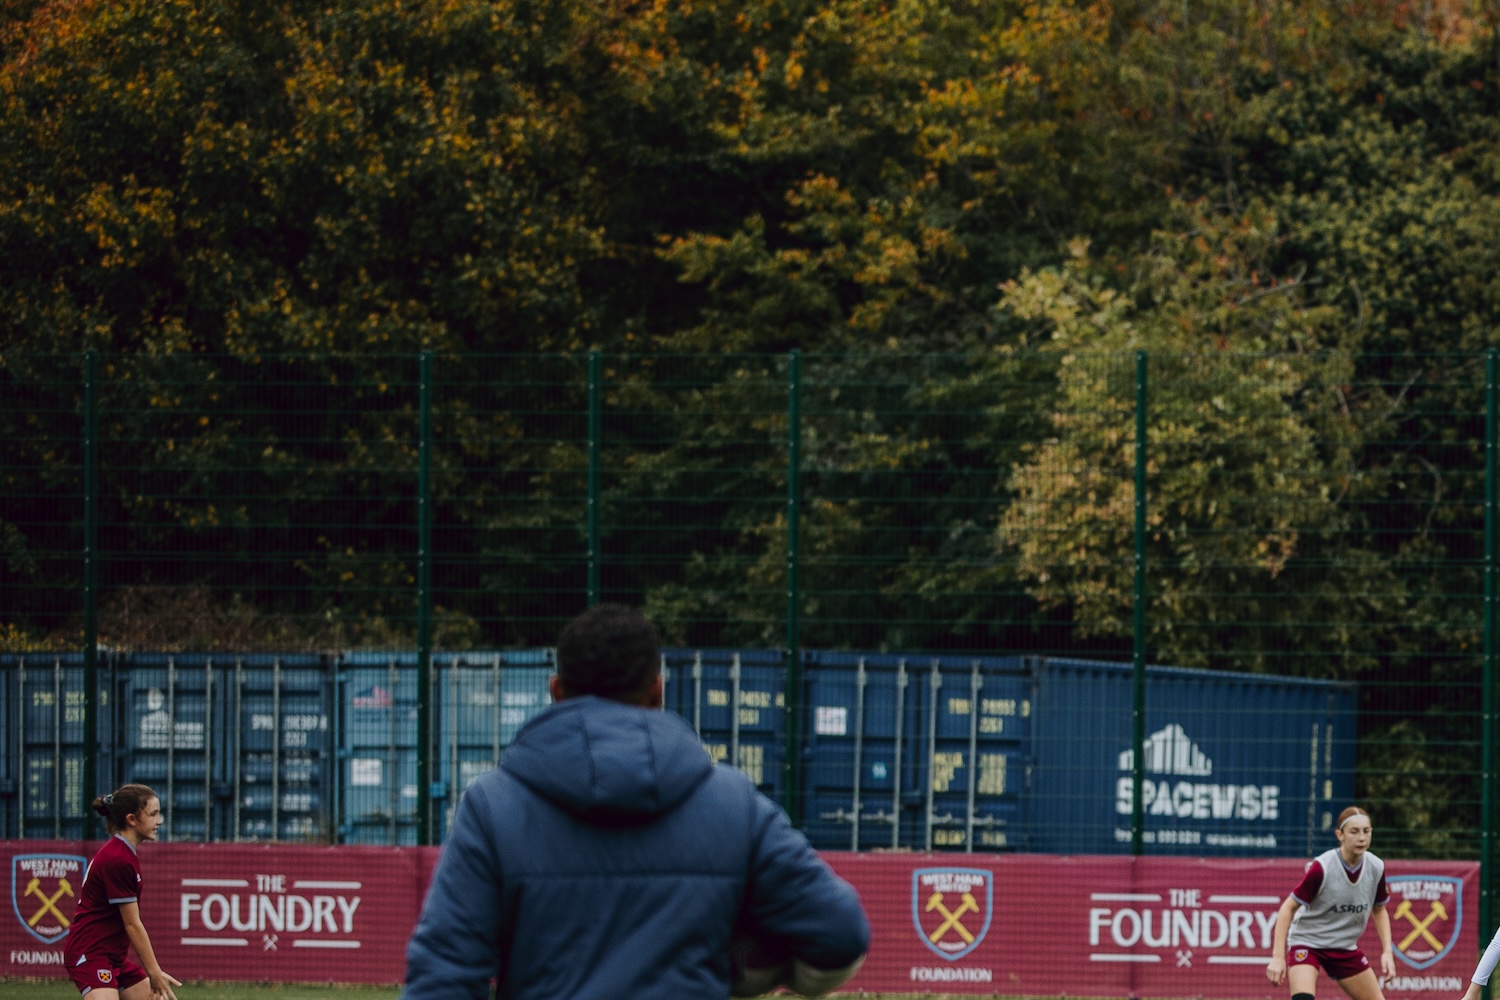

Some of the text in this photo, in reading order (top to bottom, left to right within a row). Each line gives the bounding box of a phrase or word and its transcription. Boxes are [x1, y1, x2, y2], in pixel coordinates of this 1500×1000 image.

[1116, 777, 1279, 820] SPACEWISE
[21, 859, 79, 872] WEST HAM
[32, 869, 67, 878] UNITED
[256, 874, 287, 893] THE
[922, 873, 984, 887] WEST HAM
[1169, 888, 1202, 908] THE
[180, 893, 361, 933] FOUNDRY
[1089, 908, 1279, 949] FOUNDRY
[10, 951, 65, 965] FOUNDAT
[910, 966, 992, 982] FOUNDATION
